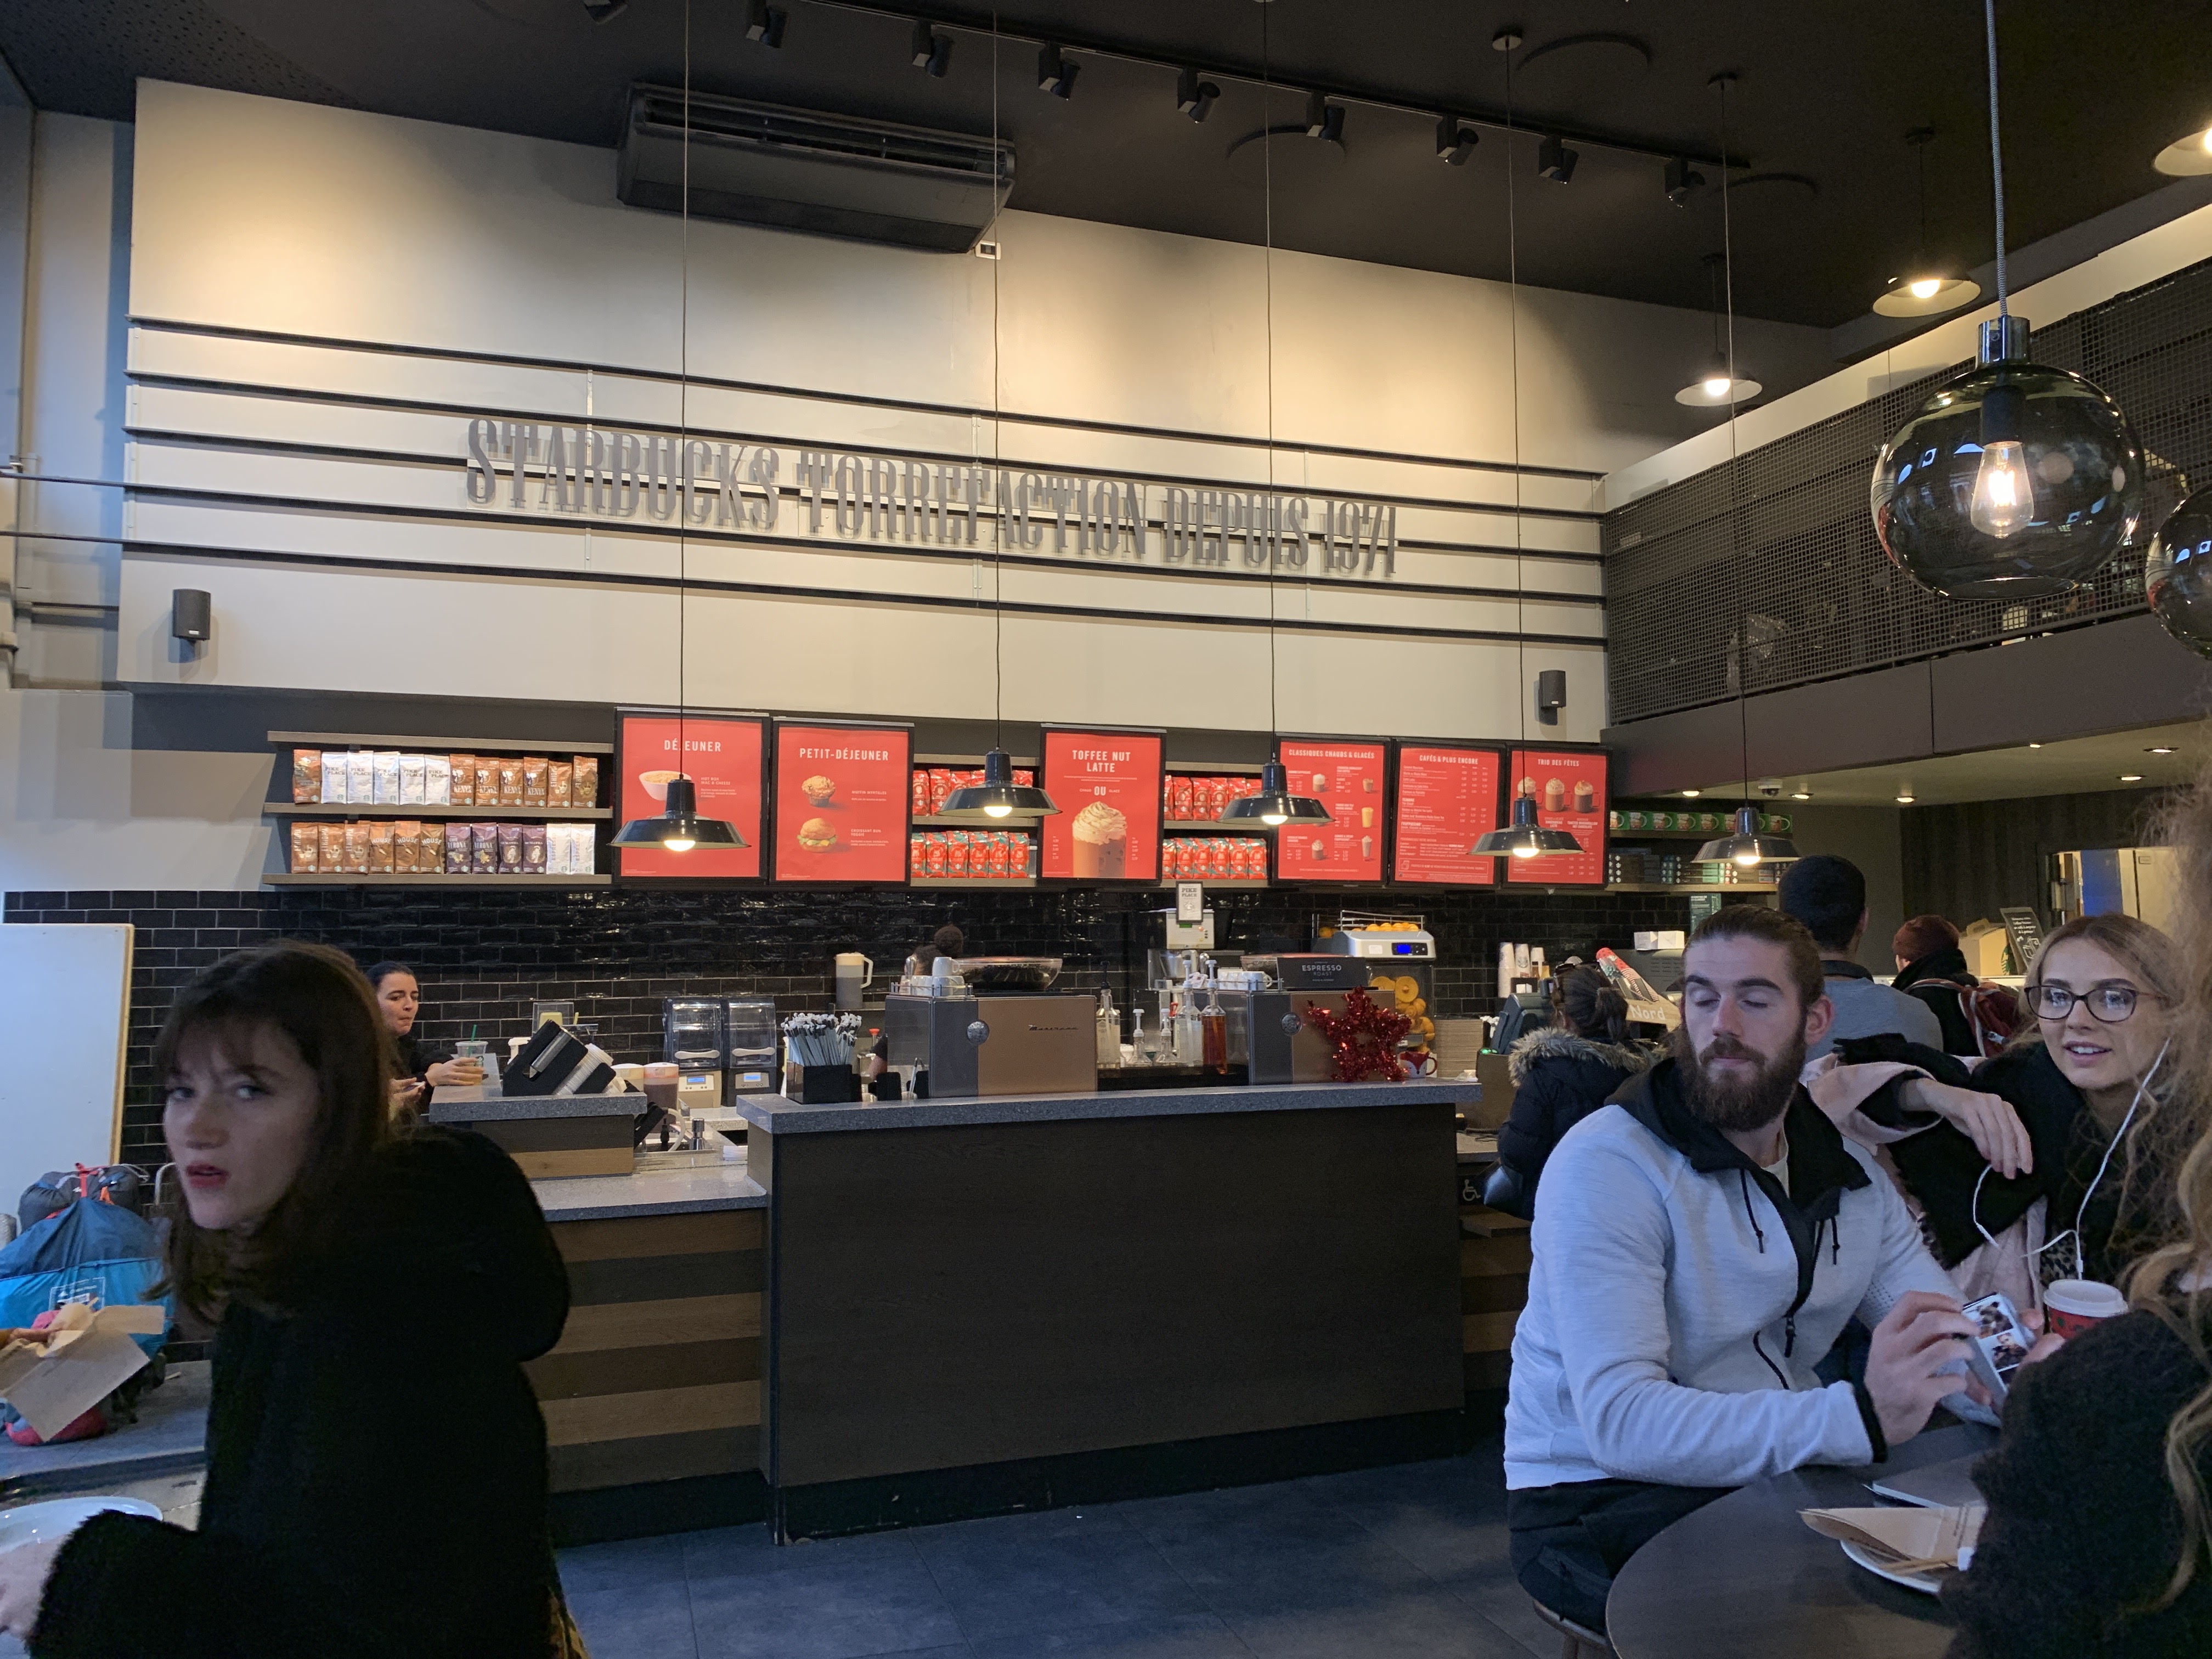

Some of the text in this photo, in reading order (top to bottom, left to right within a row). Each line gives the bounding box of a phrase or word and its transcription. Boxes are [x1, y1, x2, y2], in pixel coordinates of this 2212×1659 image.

[466, 418, 1397, 574] STARBUCKS TORREFACTION DEPUIS 1971
[664, 738, 721, 752] DÉEUNER
[799, 747, 889, 761] PETIT-DÉJEUNER
[1072, 750, 1131, 761] TOFFEE NUT
[1289, 749, 1323, 757] CLASSIQUES
[1087, 762, 1115, 772] LATTE
[1564, 759, 1579, 767] FÊTES
[528, 787, 545, 795] KENYA
[1094, 786, 1107, 796] OU
[1628, 1005, 1666, 1020] Nord
